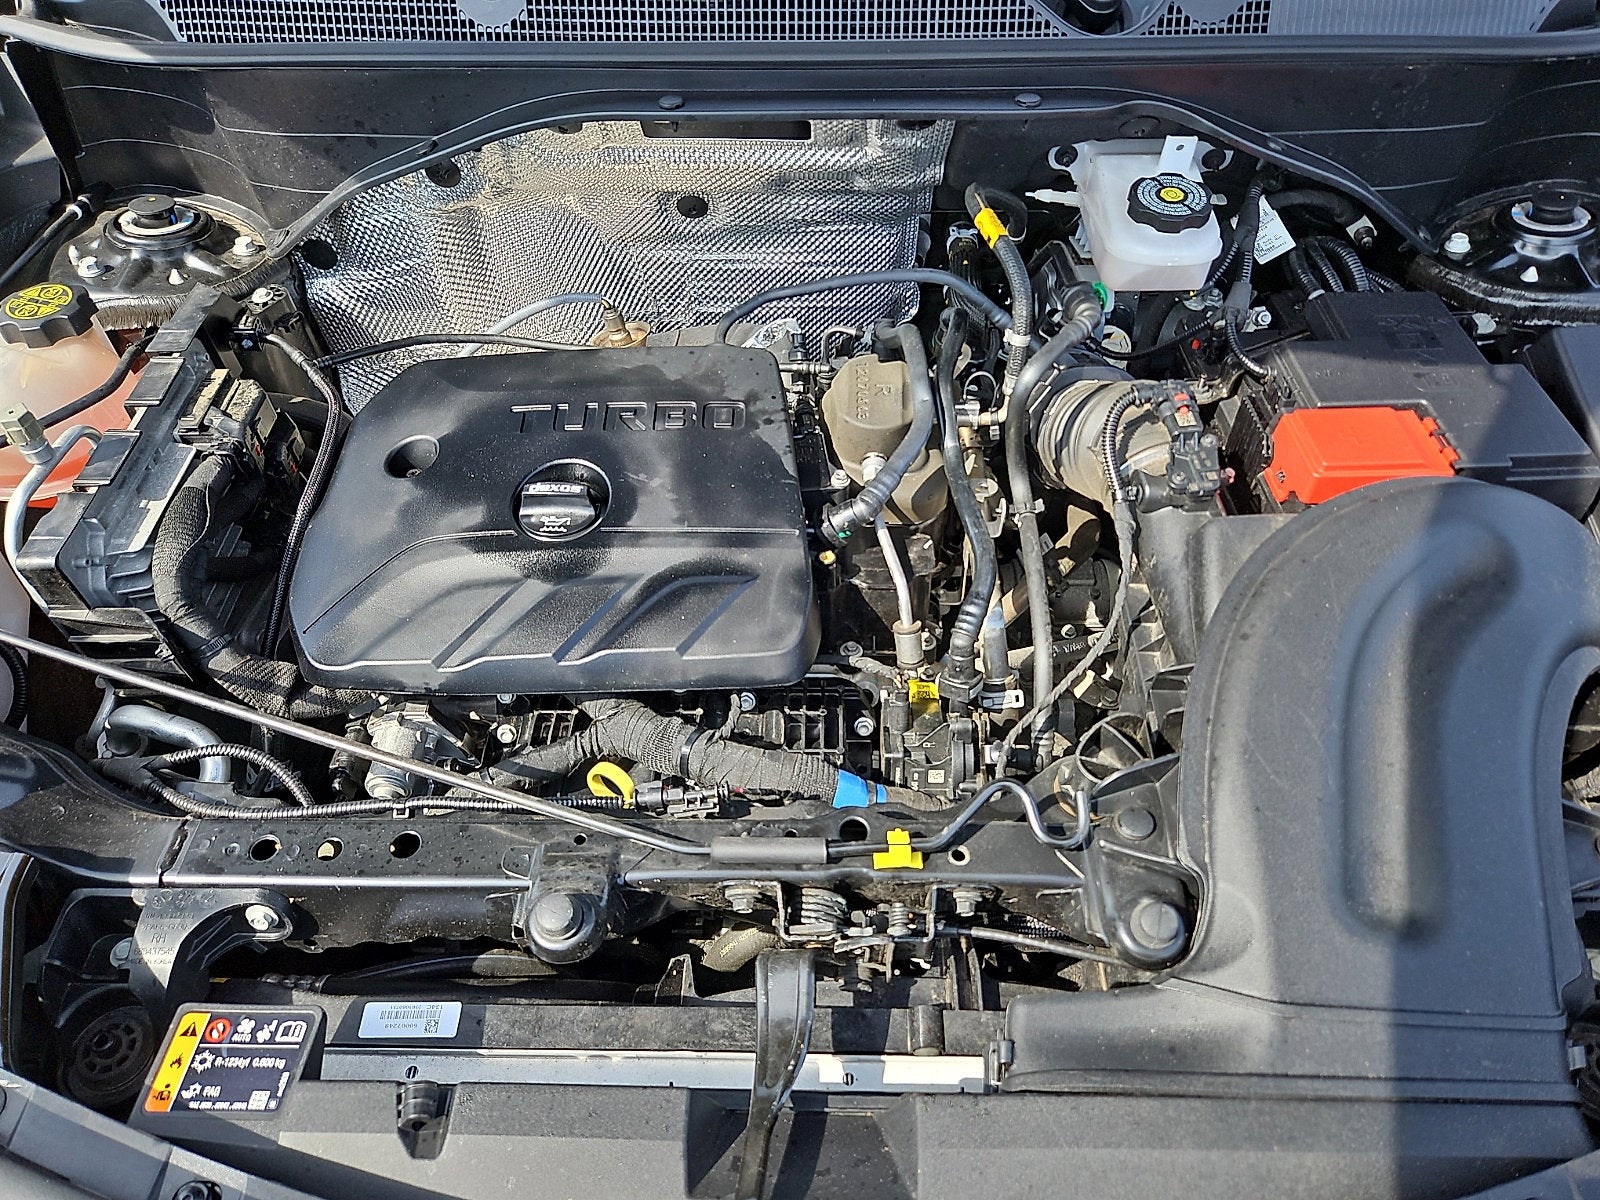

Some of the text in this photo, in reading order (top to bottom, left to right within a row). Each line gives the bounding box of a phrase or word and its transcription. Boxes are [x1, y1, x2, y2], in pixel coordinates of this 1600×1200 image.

[510, 402, 747, 433] TURBO
[527, 482, 584, 495] dexos
[151, 932, 167, 944] RH
[231, 1032, 252, 1043] AUTO
[203, 1085, 222, 1098] PAG
